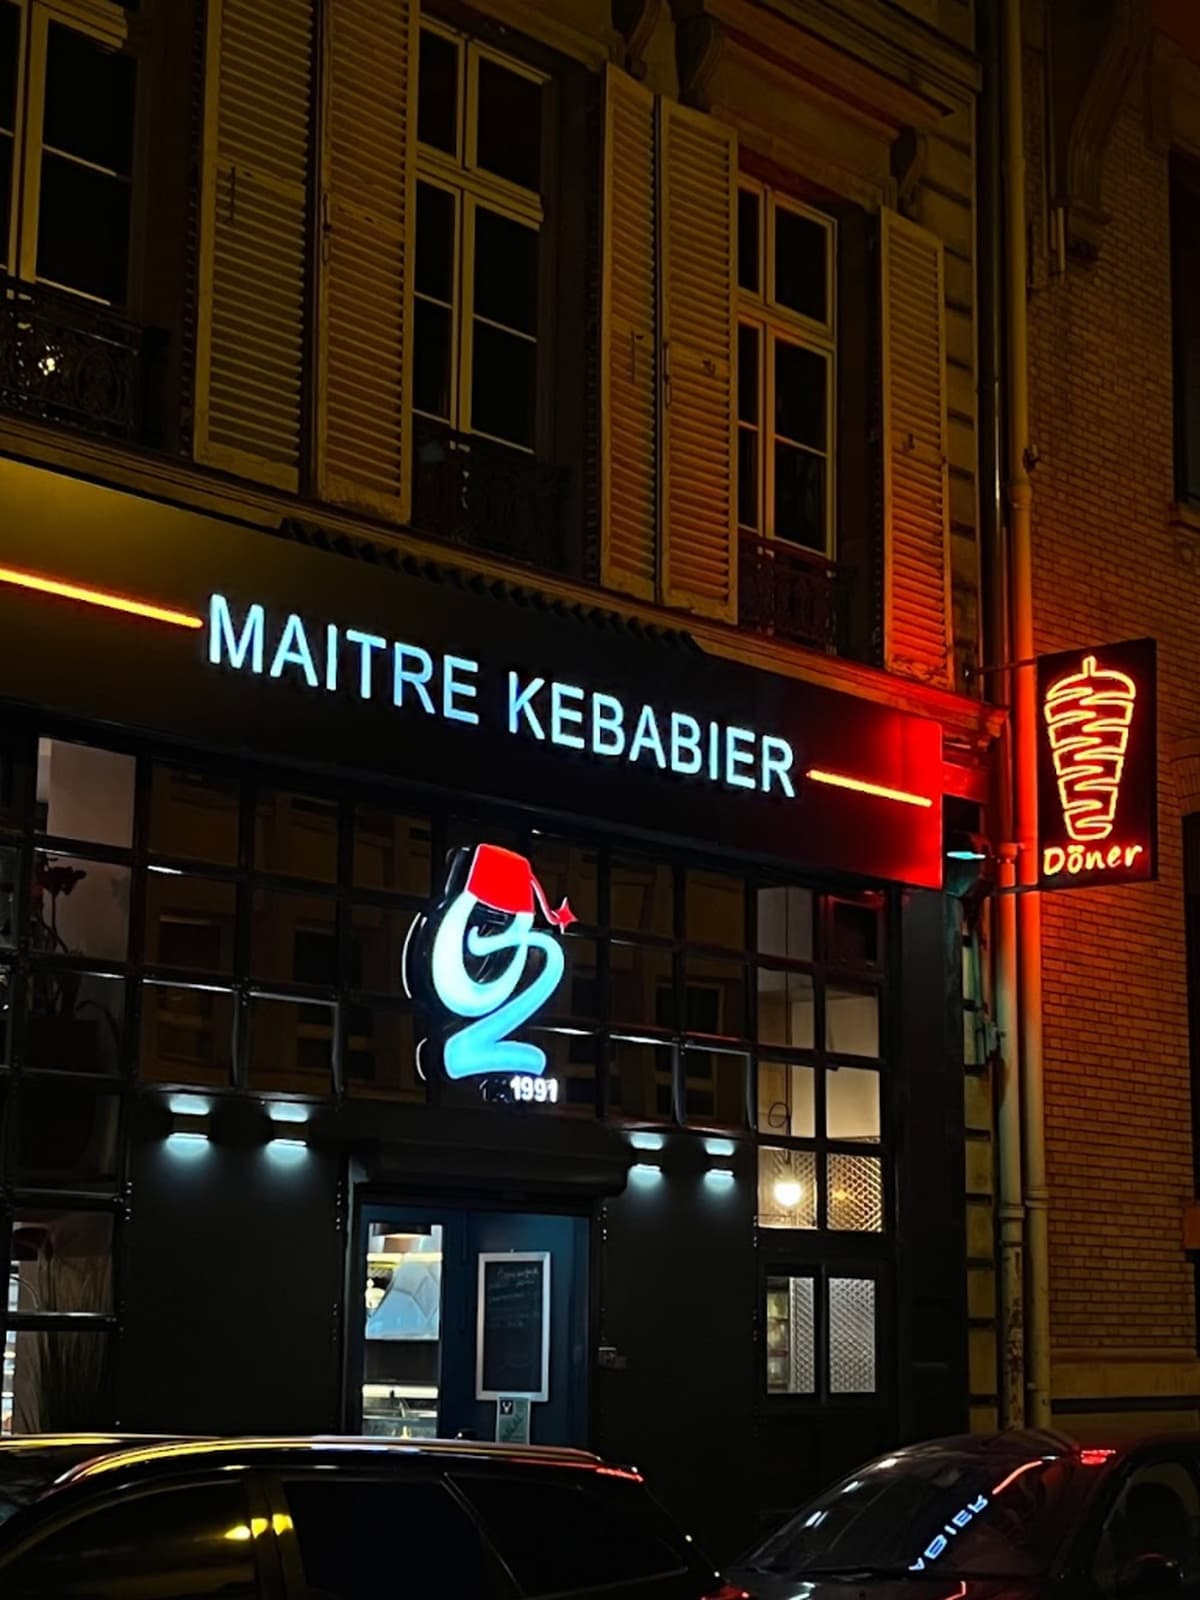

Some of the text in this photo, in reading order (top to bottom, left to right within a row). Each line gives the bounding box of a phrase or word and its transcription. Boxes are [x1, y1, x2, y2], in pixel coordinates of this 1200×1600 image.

[208, 593, 795, 798] MAITRE KEBABIER
[1043, 844, 1143, 876] Döner
[510, 1076, 558, 1103] 1991
